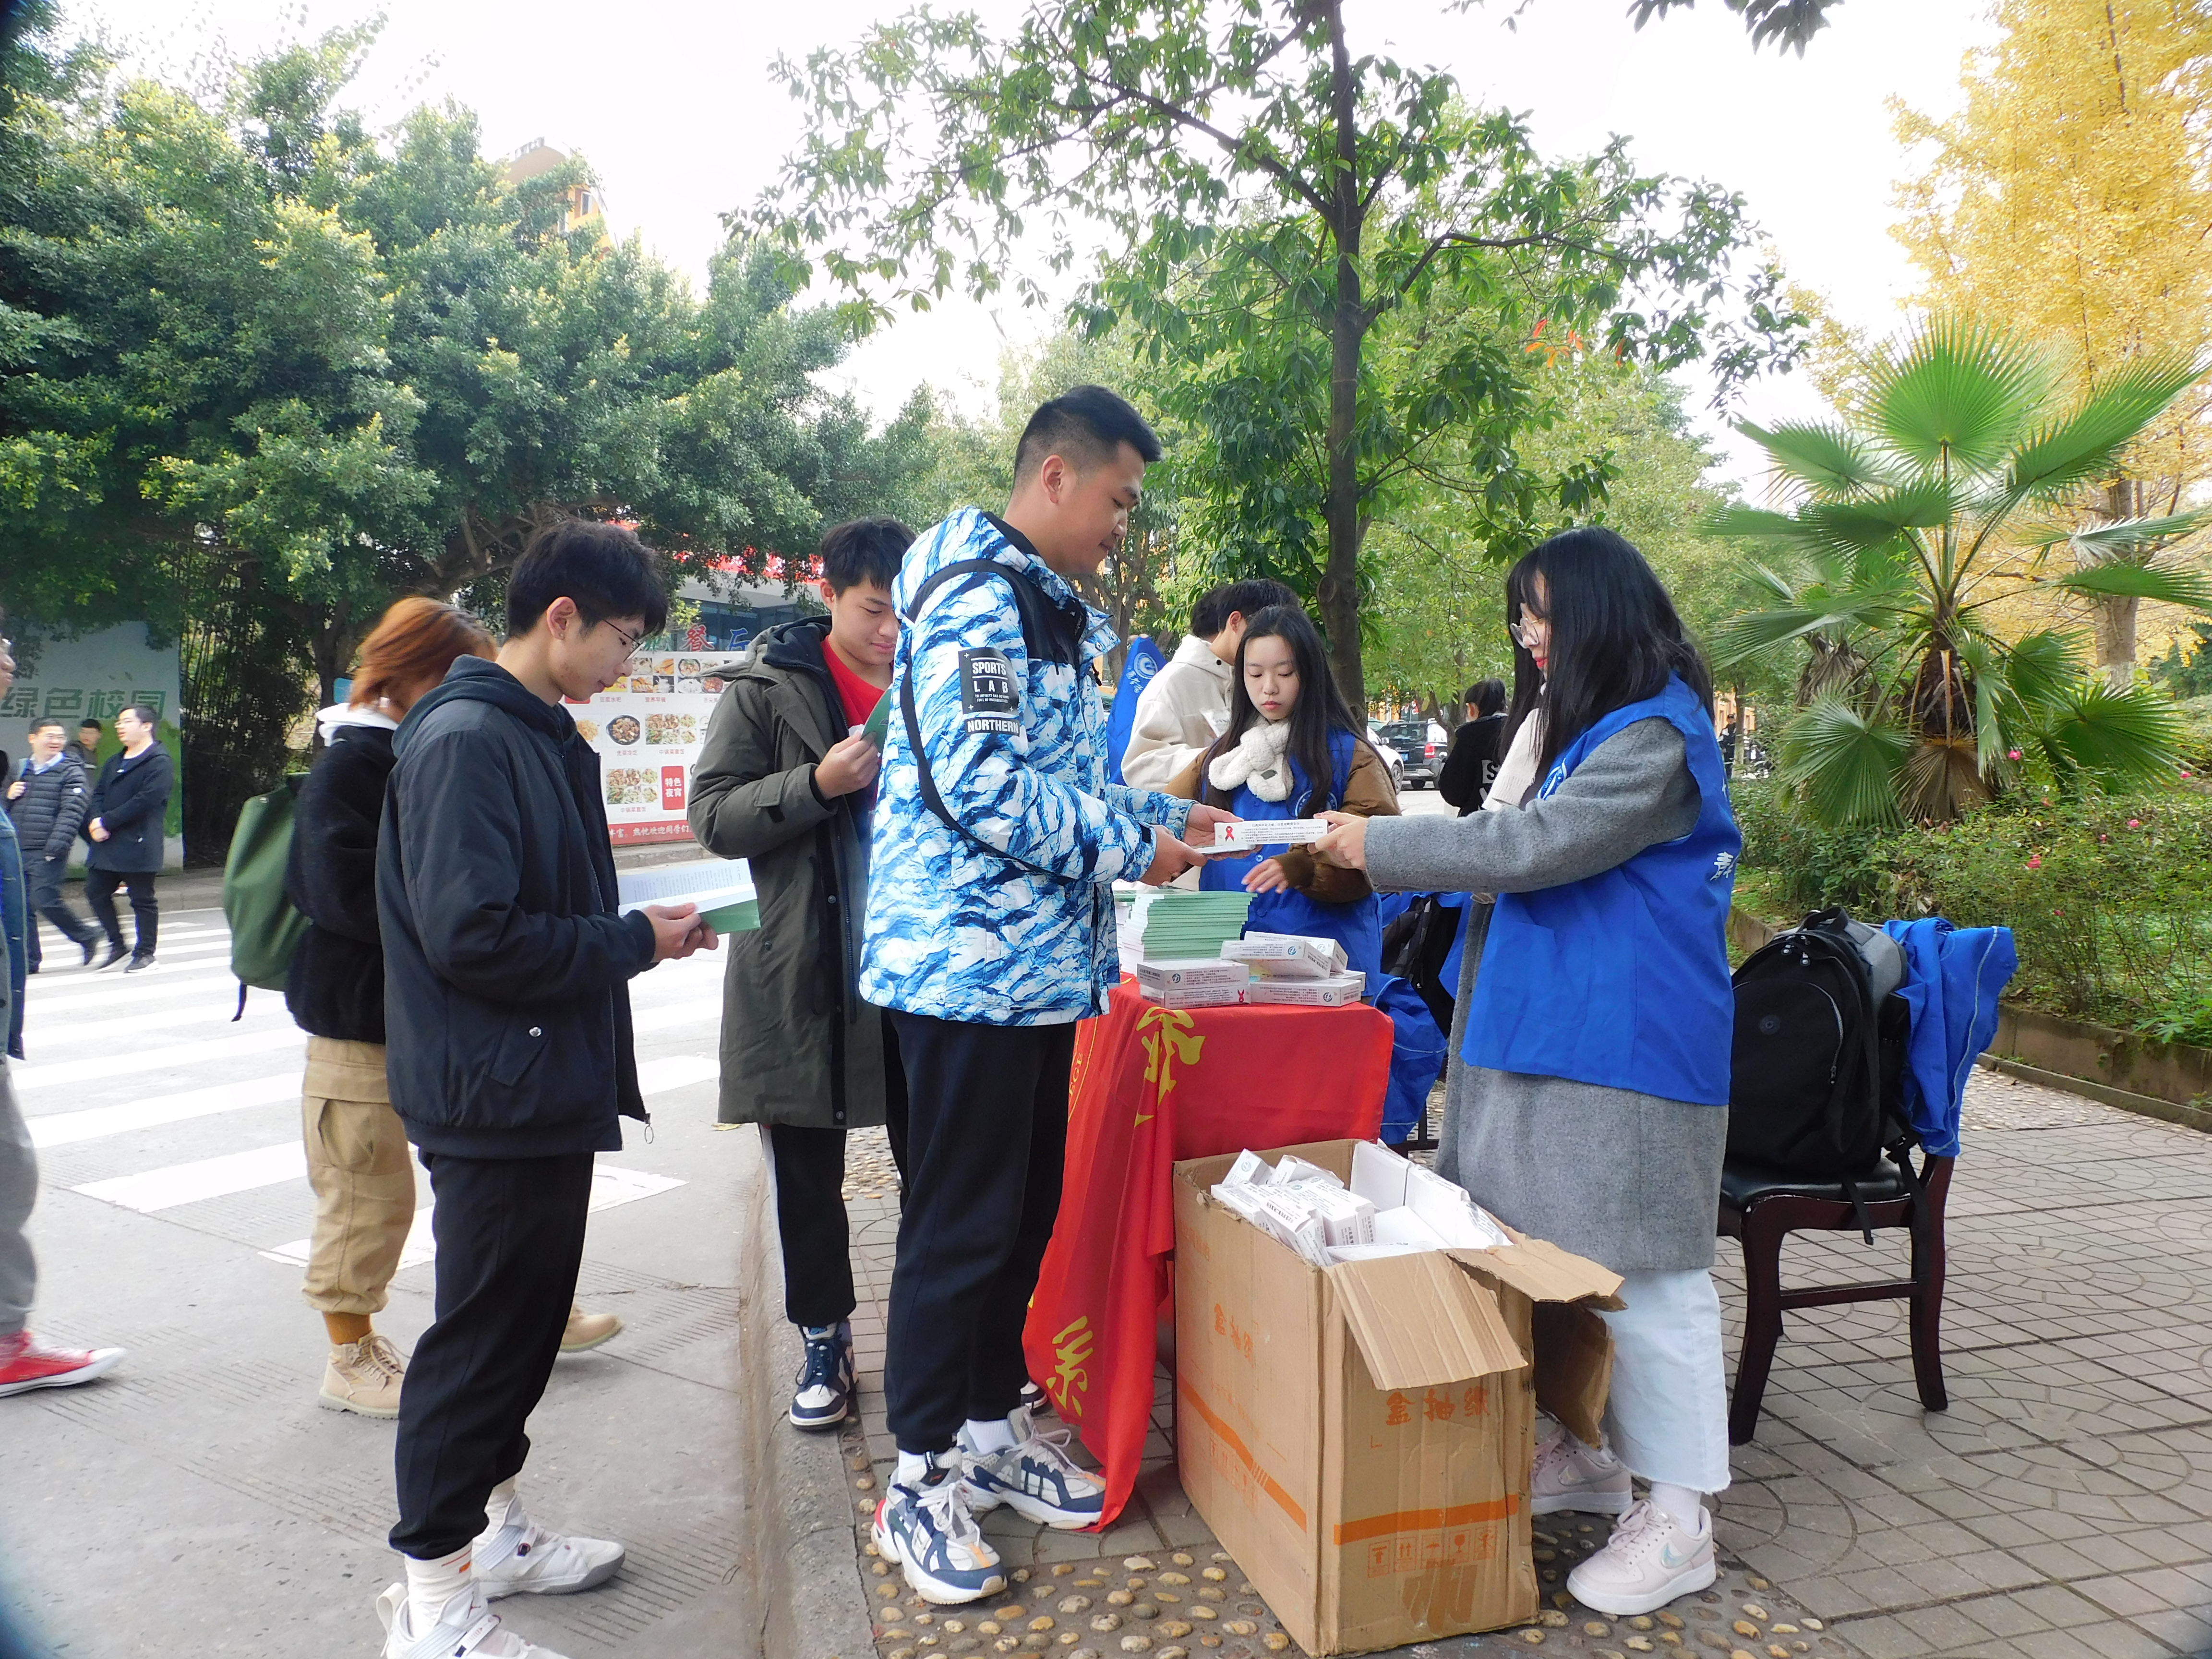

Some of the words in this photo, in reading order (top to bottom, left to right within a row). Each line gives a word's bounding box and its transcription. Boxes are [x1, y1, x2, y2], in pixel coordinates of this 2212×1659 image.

[972, 661, 1007, 675] SPORTS
[0, 687, 167, 720] 绿色校园
[967, 719, 1019, 734] NORTHERN
[664, 777, 682, 787] 特色
[665, 788, 682, 797] 夜宵
